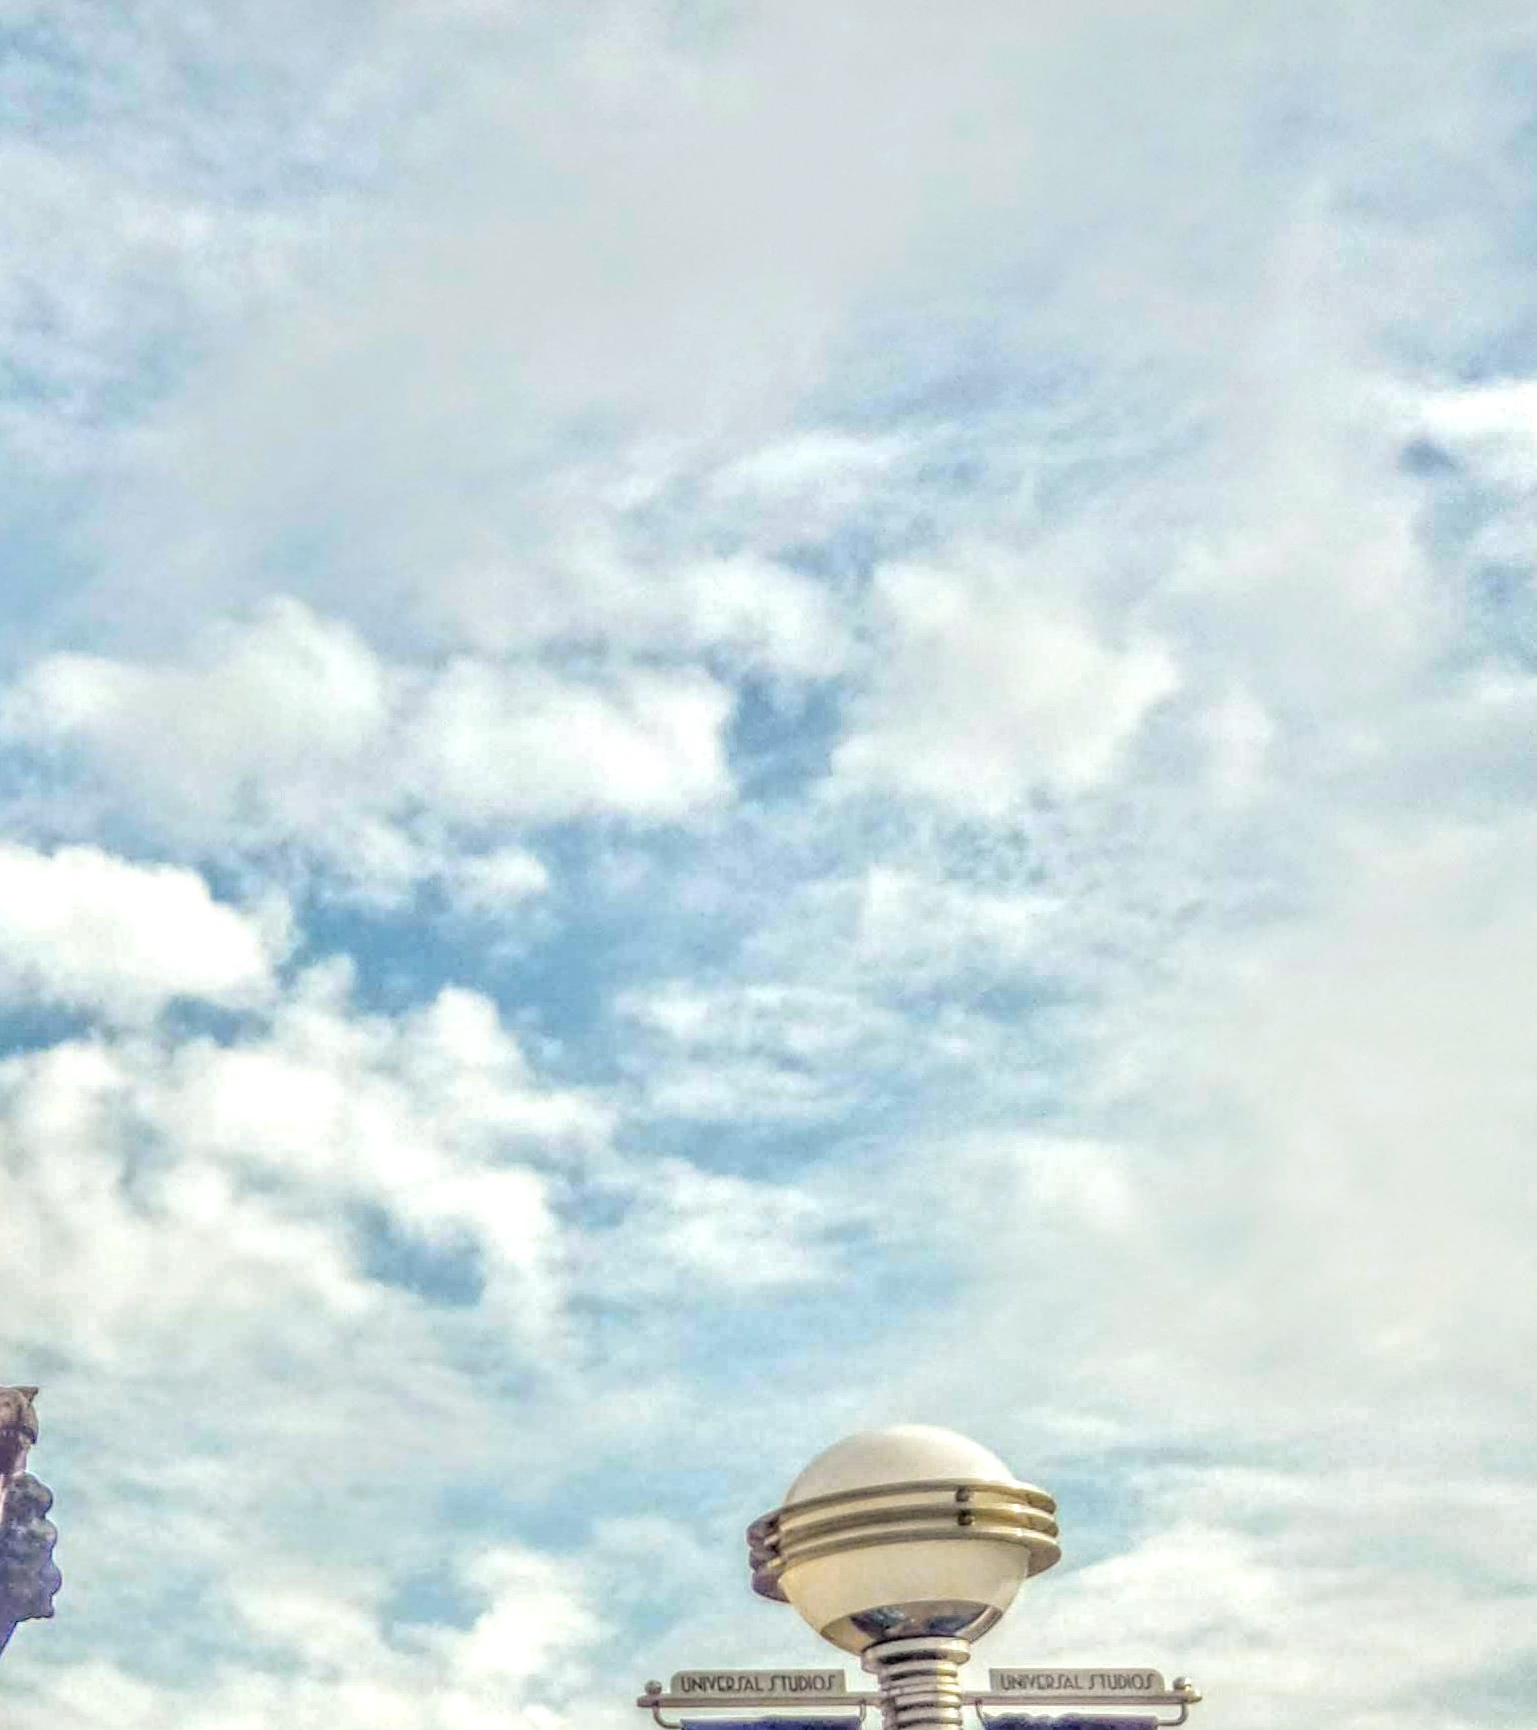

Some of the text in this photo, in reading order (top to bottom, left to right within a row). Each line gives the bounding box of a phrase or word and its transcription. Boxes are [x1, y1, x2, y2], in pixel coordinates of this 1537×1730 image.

[680, 1675, 836, 1693] UNIVERSAL STUDIOS
[999, 1673, 1155, 1691] UNIVERSAL STUDIOS
